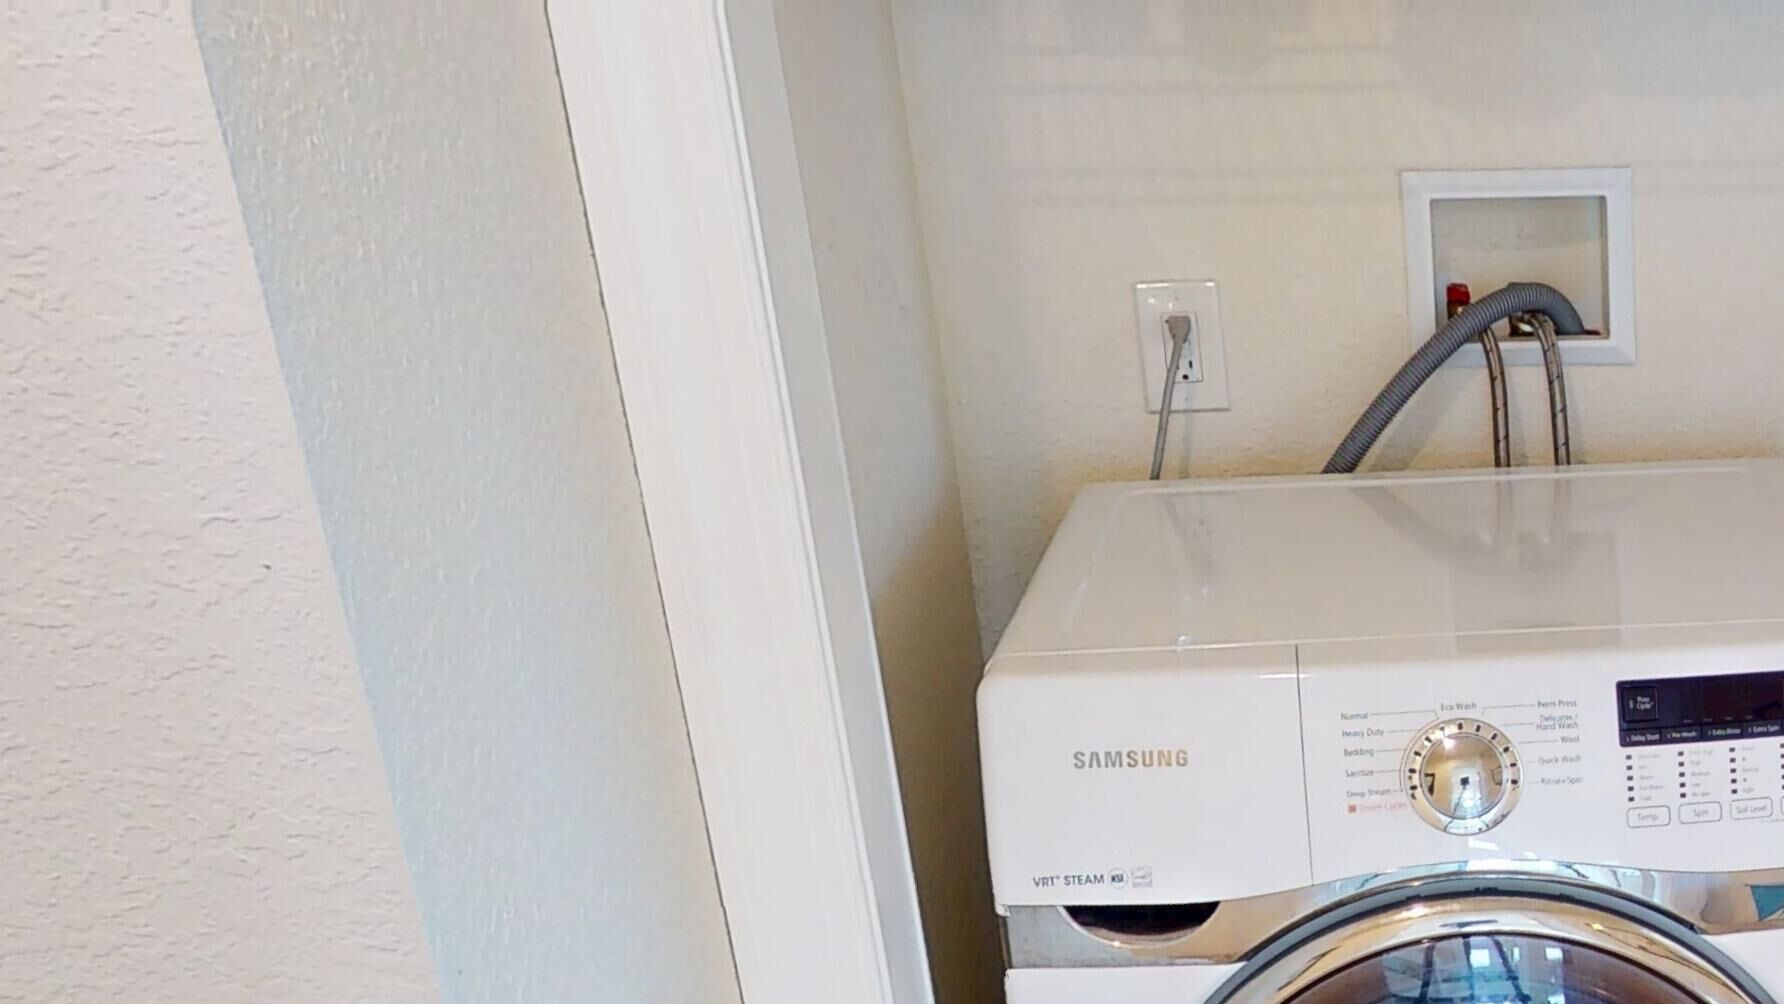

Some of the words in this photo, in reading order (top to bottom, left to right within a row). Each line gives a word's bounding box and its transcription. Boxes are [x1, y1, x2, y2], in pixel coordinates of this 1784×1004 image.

[1441, 703, 1455, 711] Eco
[1456, 702, 1477, 710] Wash
[1073, 749, 1189, 770] SAMSUNG
[1064, 874, 1104, 886] STEAM
